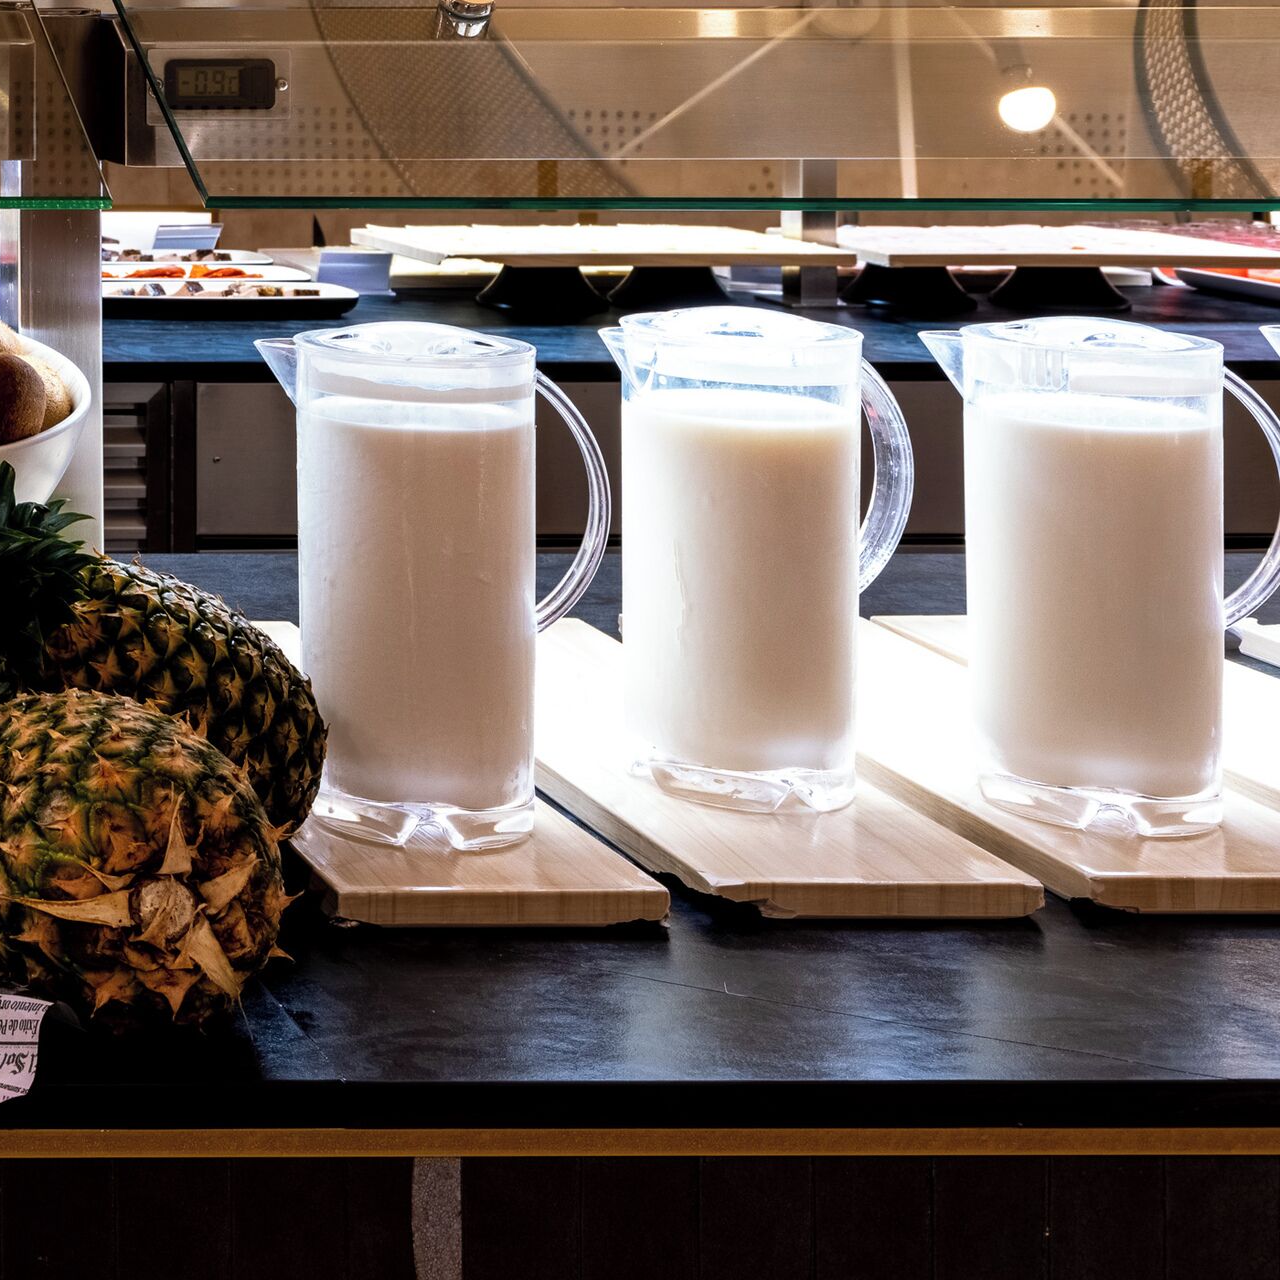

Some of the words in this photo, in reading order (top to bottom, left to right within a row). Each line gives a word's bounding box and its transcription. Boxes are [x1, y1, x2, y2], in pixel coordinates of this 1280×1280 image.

[11, 1000, 42, 1015] intento
[7, 1018, 19, 1036] de
[19, 1019, 41, 1039] Éxito
